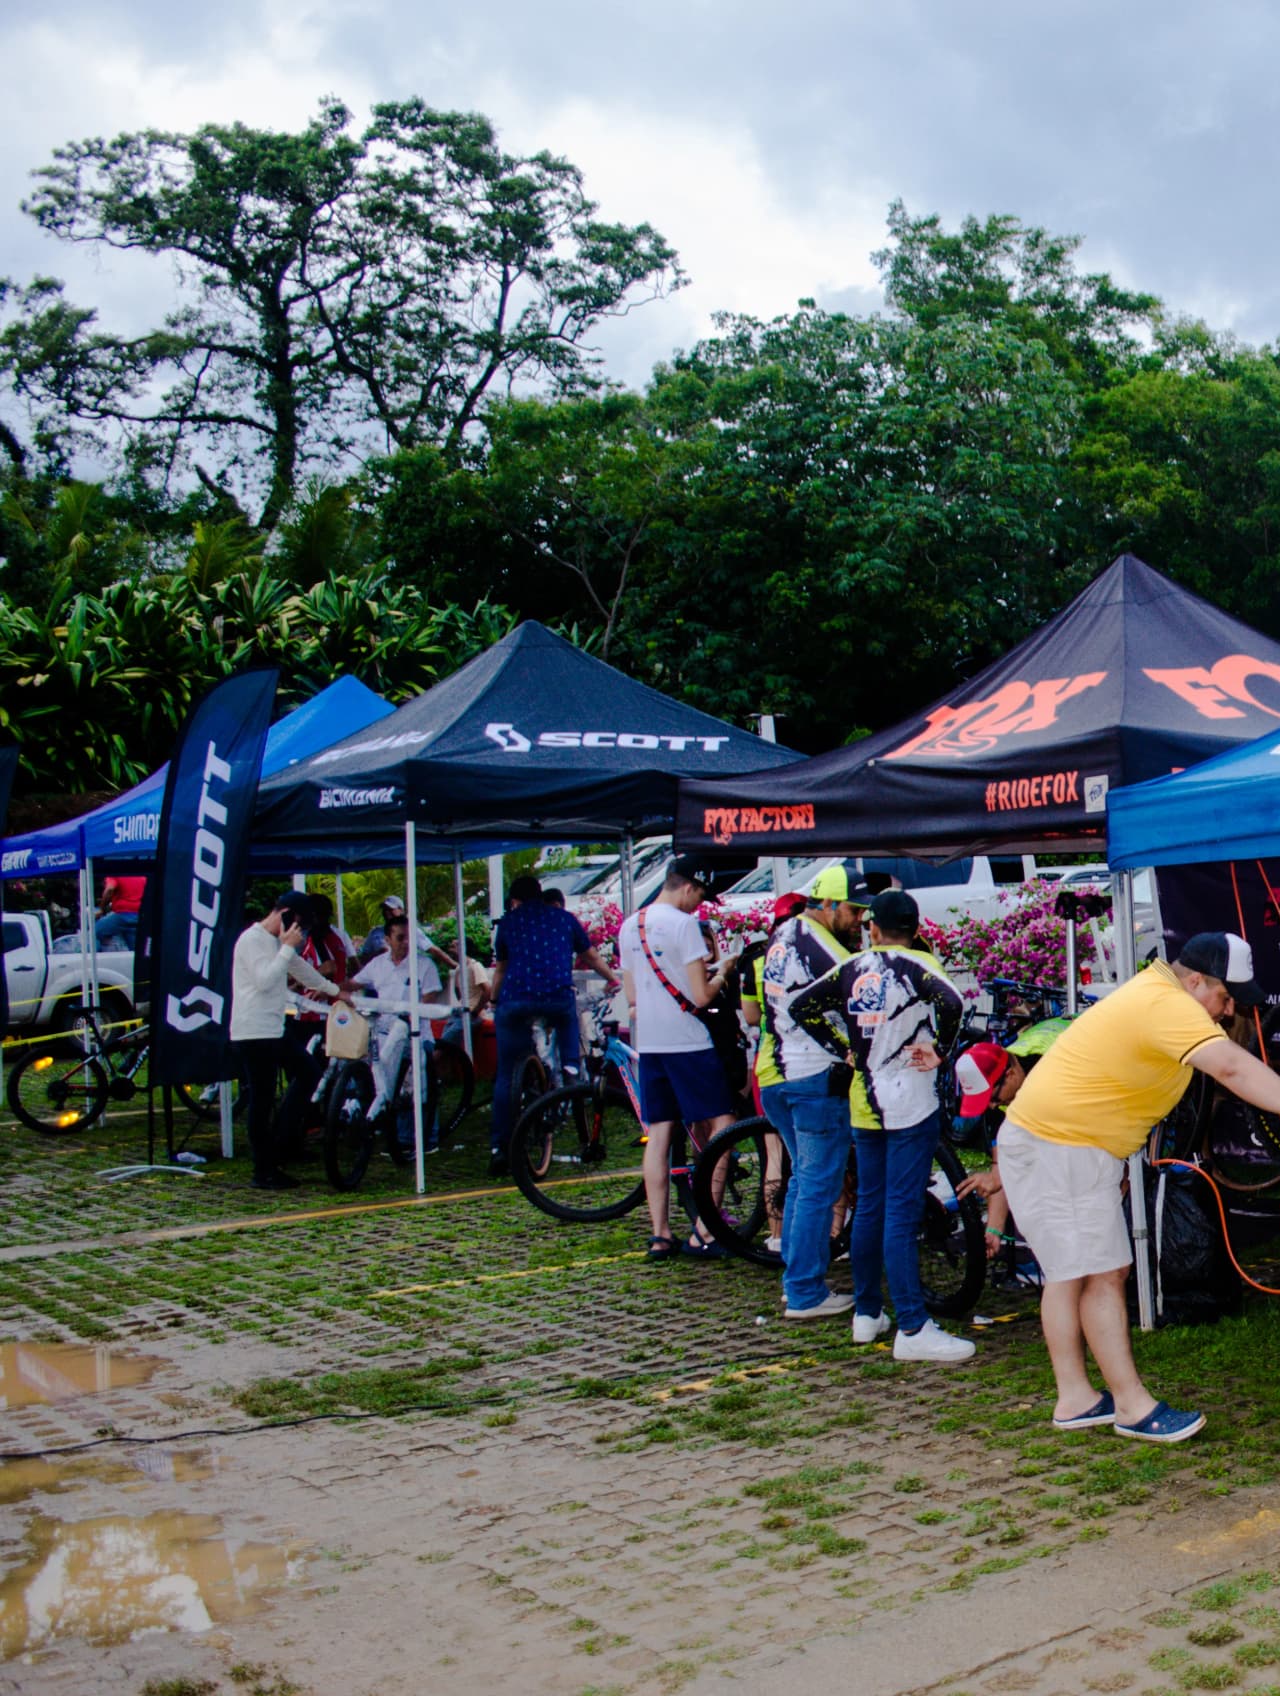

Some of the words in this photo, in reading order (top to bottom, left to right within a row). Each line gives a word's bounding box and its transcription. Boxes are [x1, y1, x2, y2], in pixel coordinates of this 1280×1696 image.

[537, 731, 730, 752] SCOTT
[985, 771, 1079, 812] #RIDEFOX
[739, 803, 815, 832] FACTORY
[188, 740, 232, 981] SCOTT
